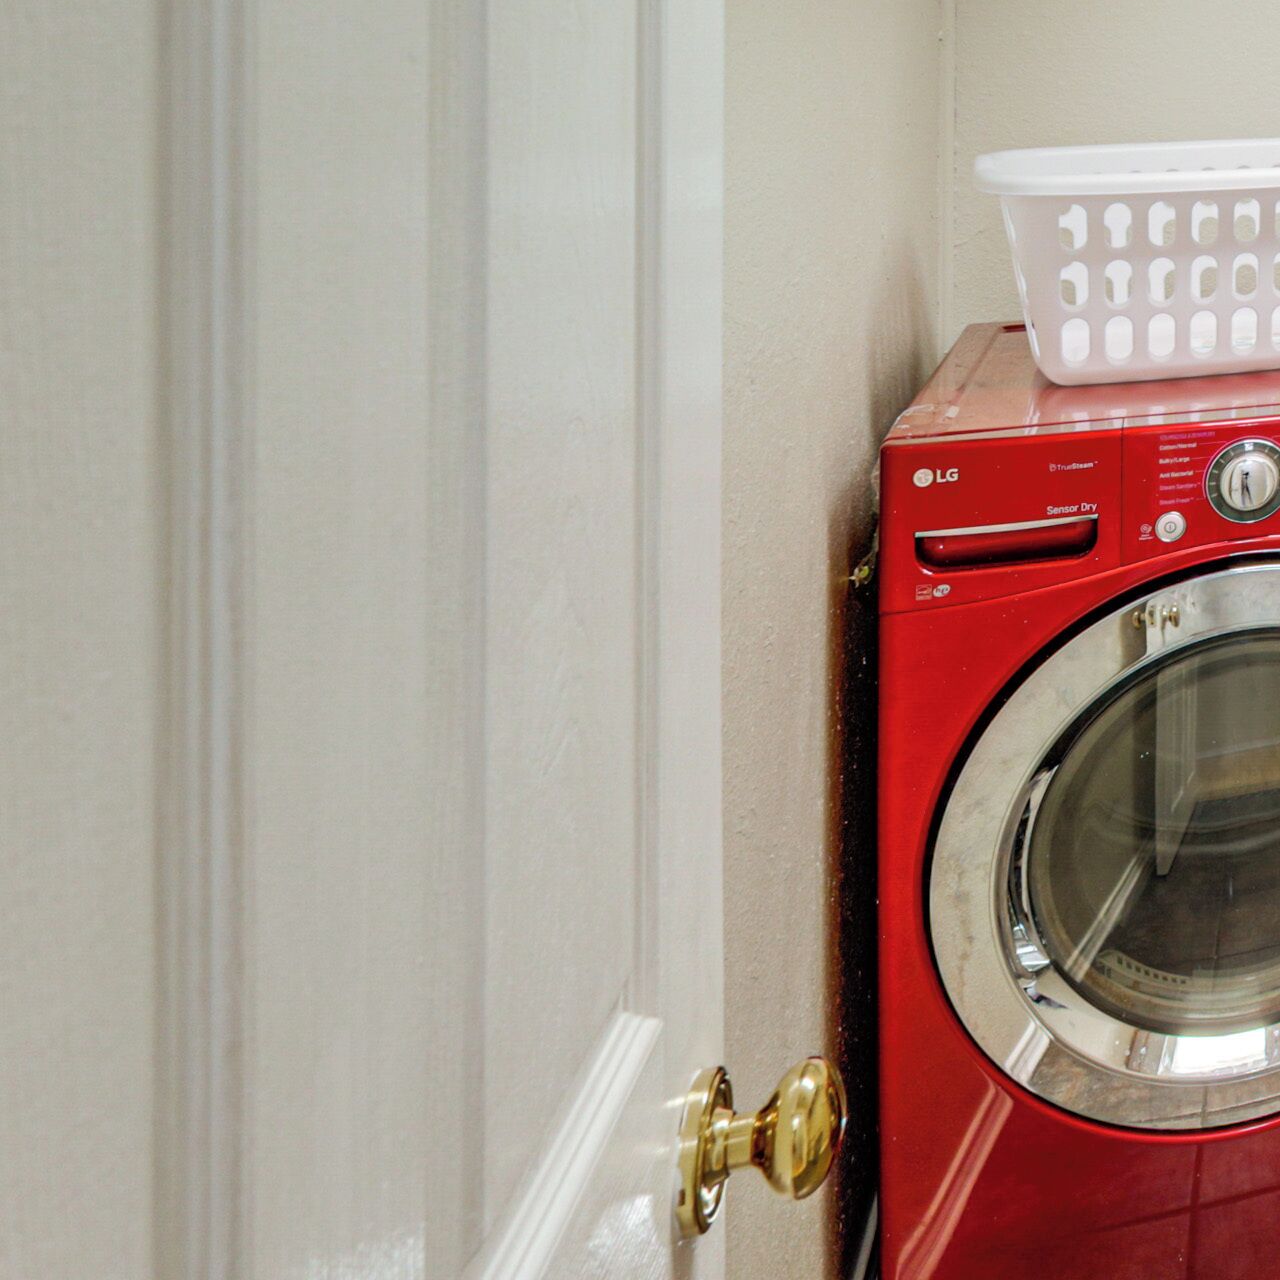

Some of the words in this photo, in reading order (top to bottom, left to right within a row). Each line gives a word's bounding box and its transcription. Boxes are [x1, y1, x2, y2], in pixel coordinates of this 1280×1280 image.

[936, 468, 959, 483] LG
[1047, 505, 1078, 515] Sensor
[1081, 503, 1098, 513] Dry
